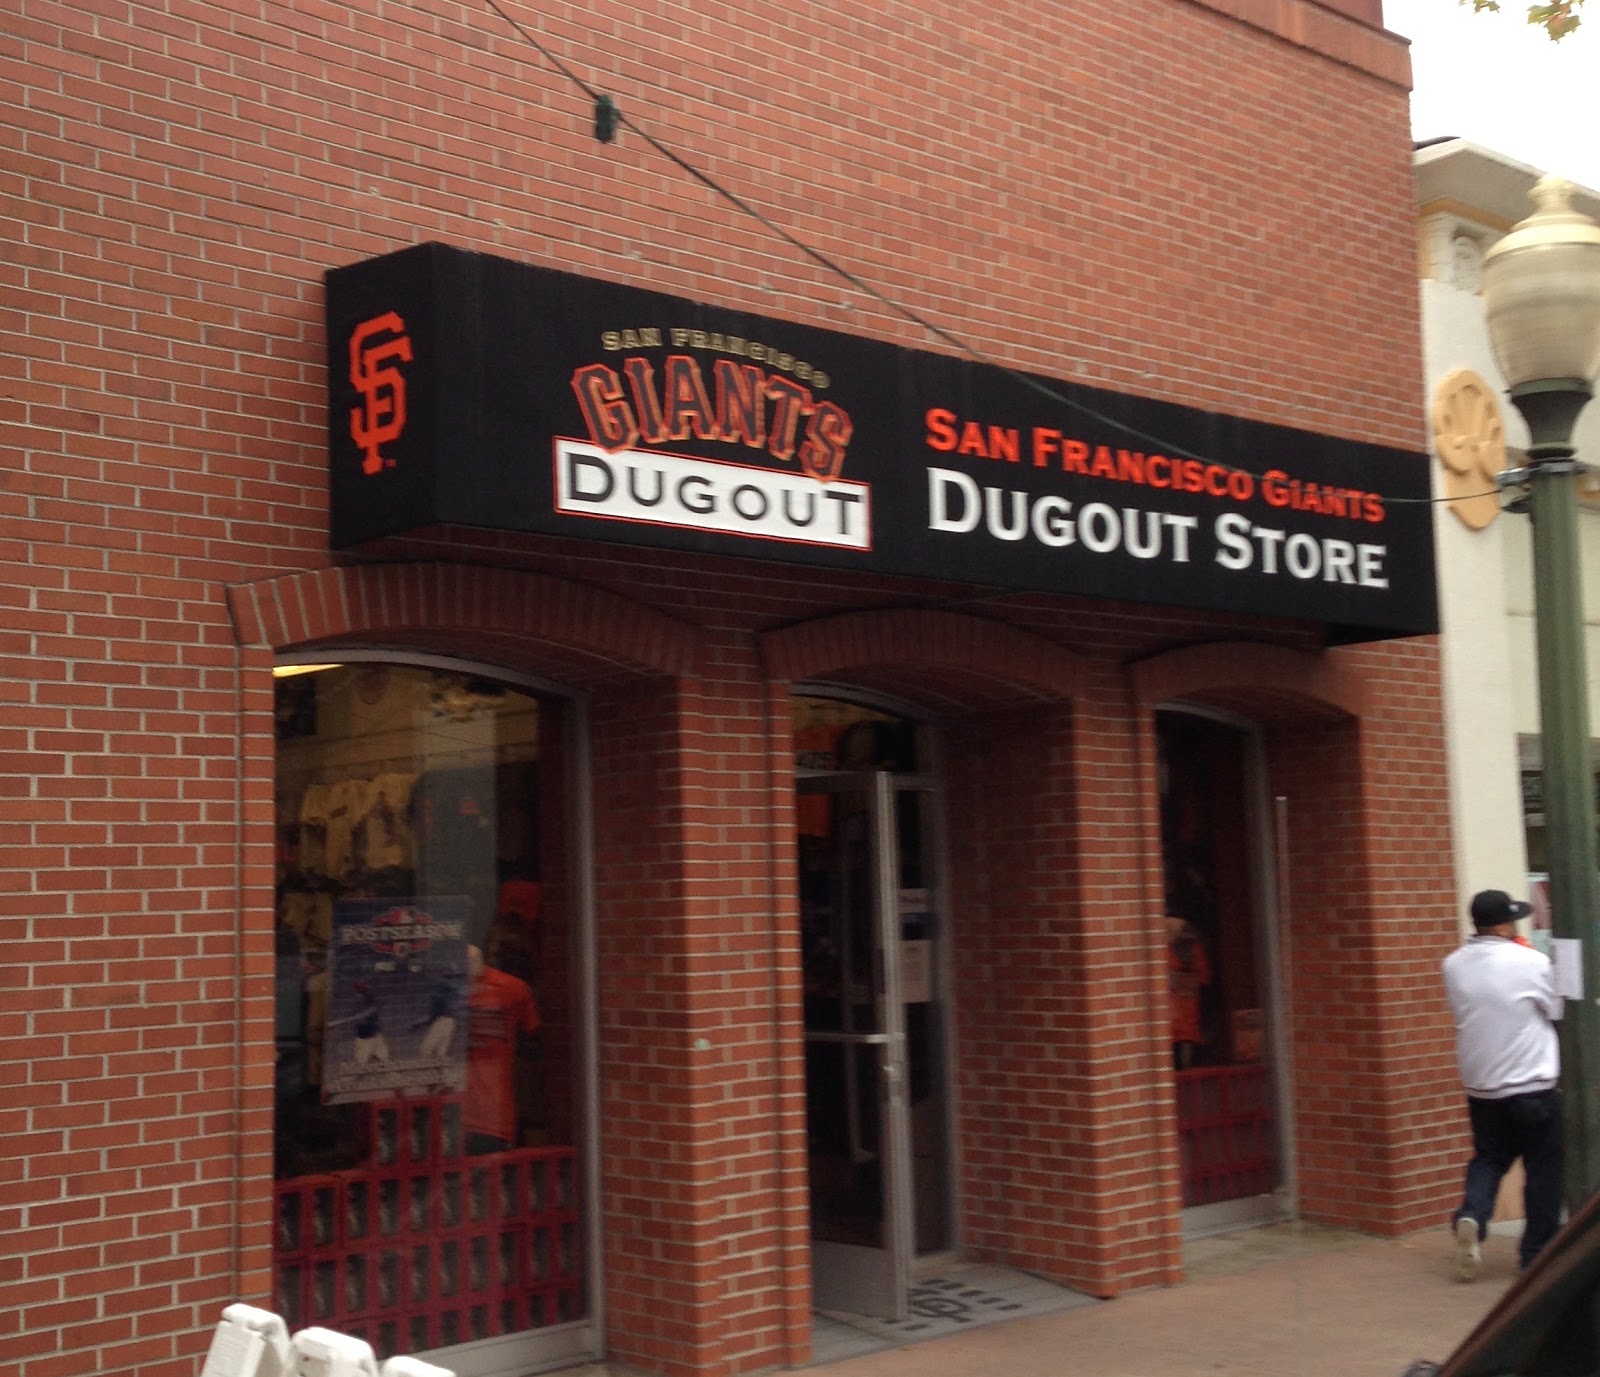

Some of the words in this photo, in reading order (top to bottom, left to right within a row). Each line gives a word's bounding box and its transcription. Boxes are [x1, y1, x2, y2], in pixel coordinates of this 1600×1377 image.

[601, 326, 663, 351] SAN
[669, 327, 831, 389] FRANCISCO
[570, 354, 854, 483] GIANTS
[924, 407, 1021, 463] SAN
[1032, 426, 1255, 501] FRANCISCO
[1261, 469, 1386, 522] GIANTS
[565, 452, 863, 536] DUGOUT
[926, 466, 1199, 563] DUGOUT
[1214, 512, 1390, 589] STORE
